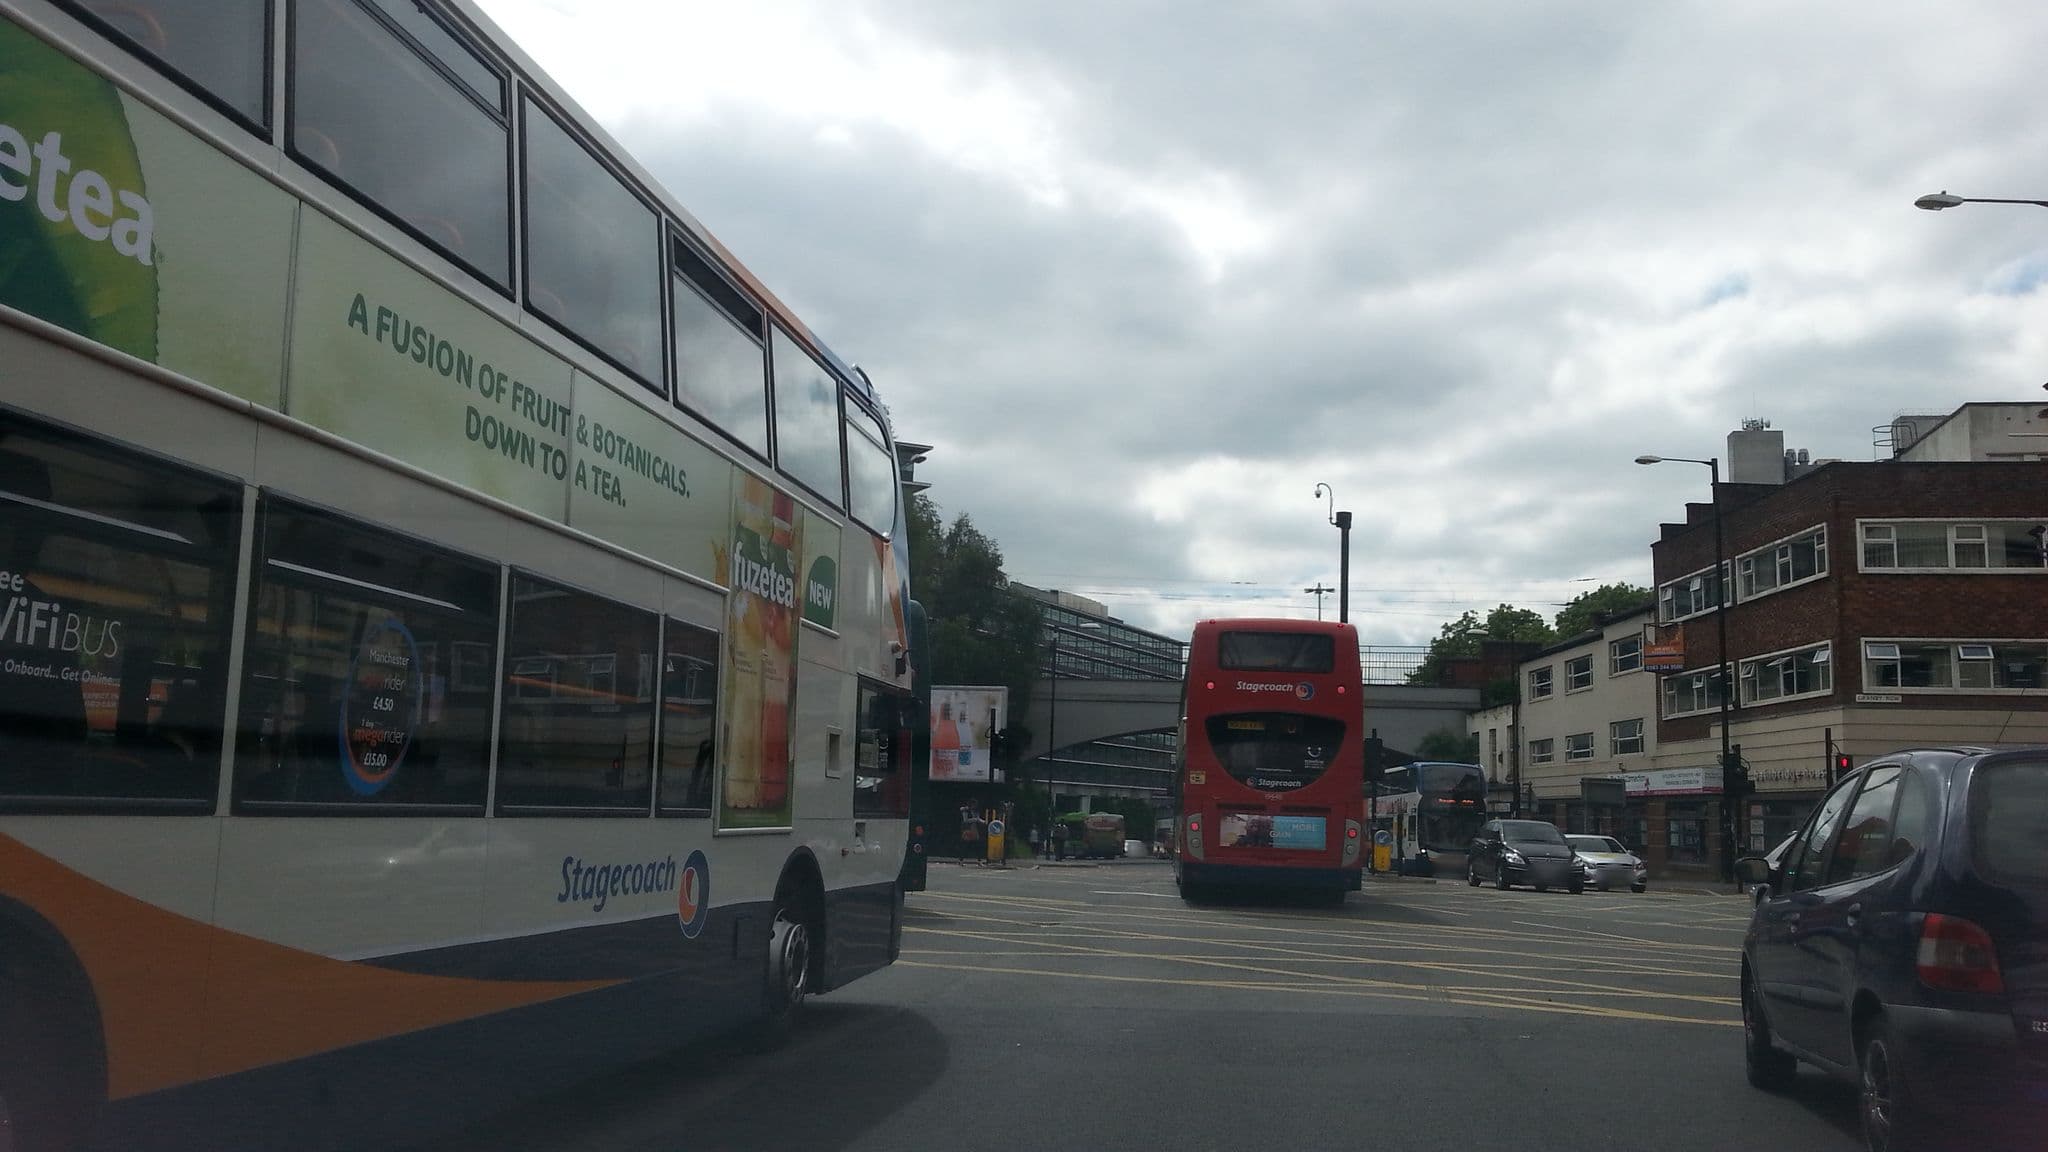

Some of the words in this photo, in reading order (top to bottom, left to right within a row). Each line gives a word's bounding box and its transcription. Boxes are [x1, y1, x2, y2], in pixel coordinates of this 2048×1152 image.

[348, 293, 369, 336] A
[376, 305, 472, 389] FUSION
[479, 364, 508, 404] OF
[512, 381, 571, 437] FRUIT
[576, 414, 588, 448] &
[593, 423, 690, 498] BOTANICALS.
[466, 406, 535, 468] DOWN
[540, 442, 567, 481] TO
[575, 459, 588, 490] A
[592, 466, 626, 507] TEA.
[735, 541, 794, 609] fuzetea
[810, 580, 832, 610] NEW
[369, 648, 410, 667] Manchester
[5, 659, 59, 680] Onboard...
[61, 667, 80, 682] Get
[1236, 681, 1293, 693] Stagecoach
[373, 696, 394, 711] £4.50
[364, 752, 387, 767] £15.00
[1258, 778, 1301, 788] Stagecoach
[558, 856, 675, 912] Stagecoach
